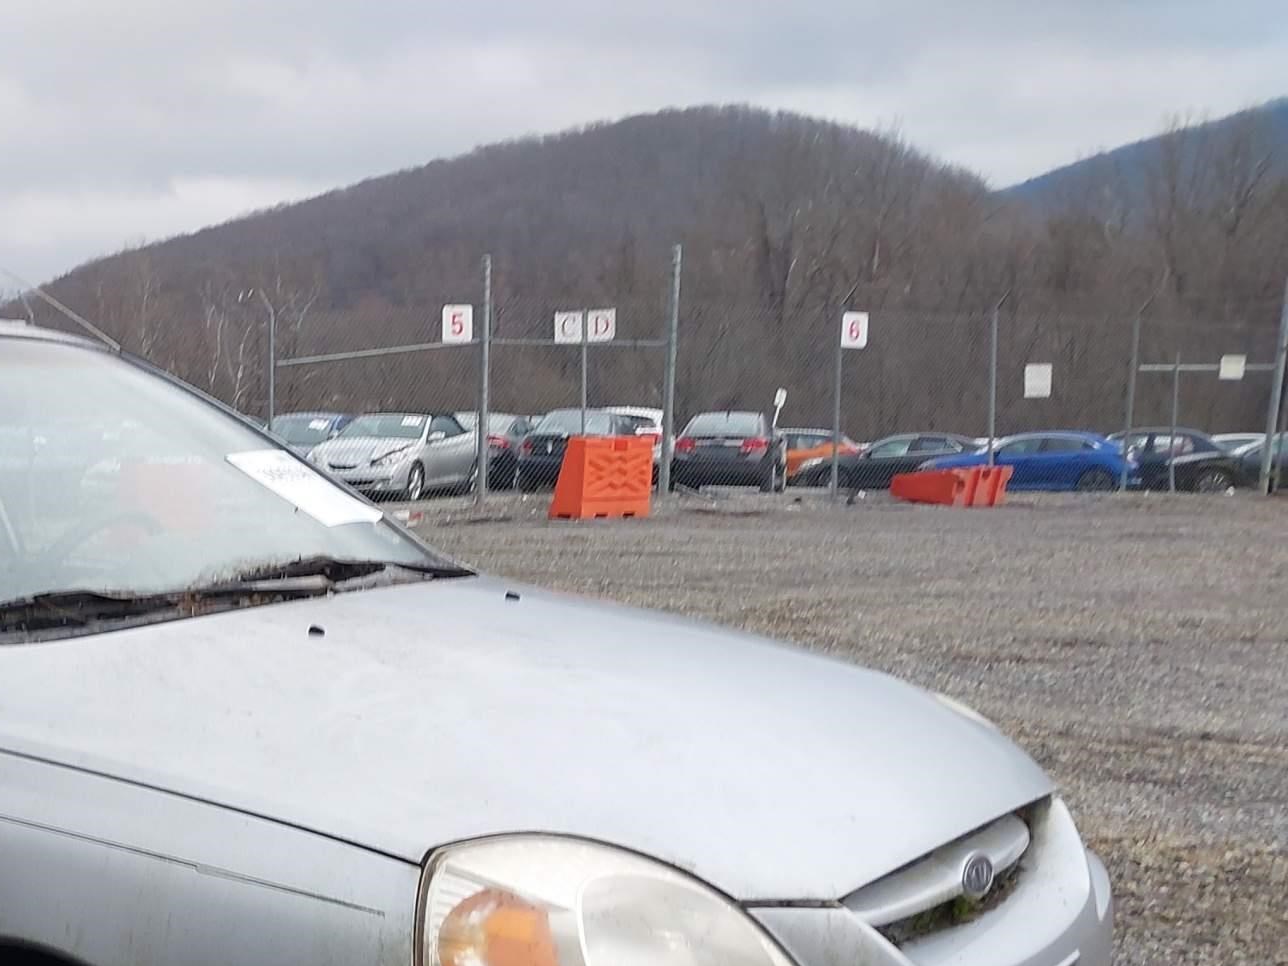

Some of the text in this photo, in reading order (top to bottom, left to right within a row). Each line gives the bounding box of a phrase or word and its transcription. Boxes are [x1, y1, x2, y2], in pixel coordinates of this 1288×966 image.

[451, 313, 463, 336] 5
[561, 316, 576, 337] C
[594, 316, 609, 336] D
[849, 319, 860, 341] 6
